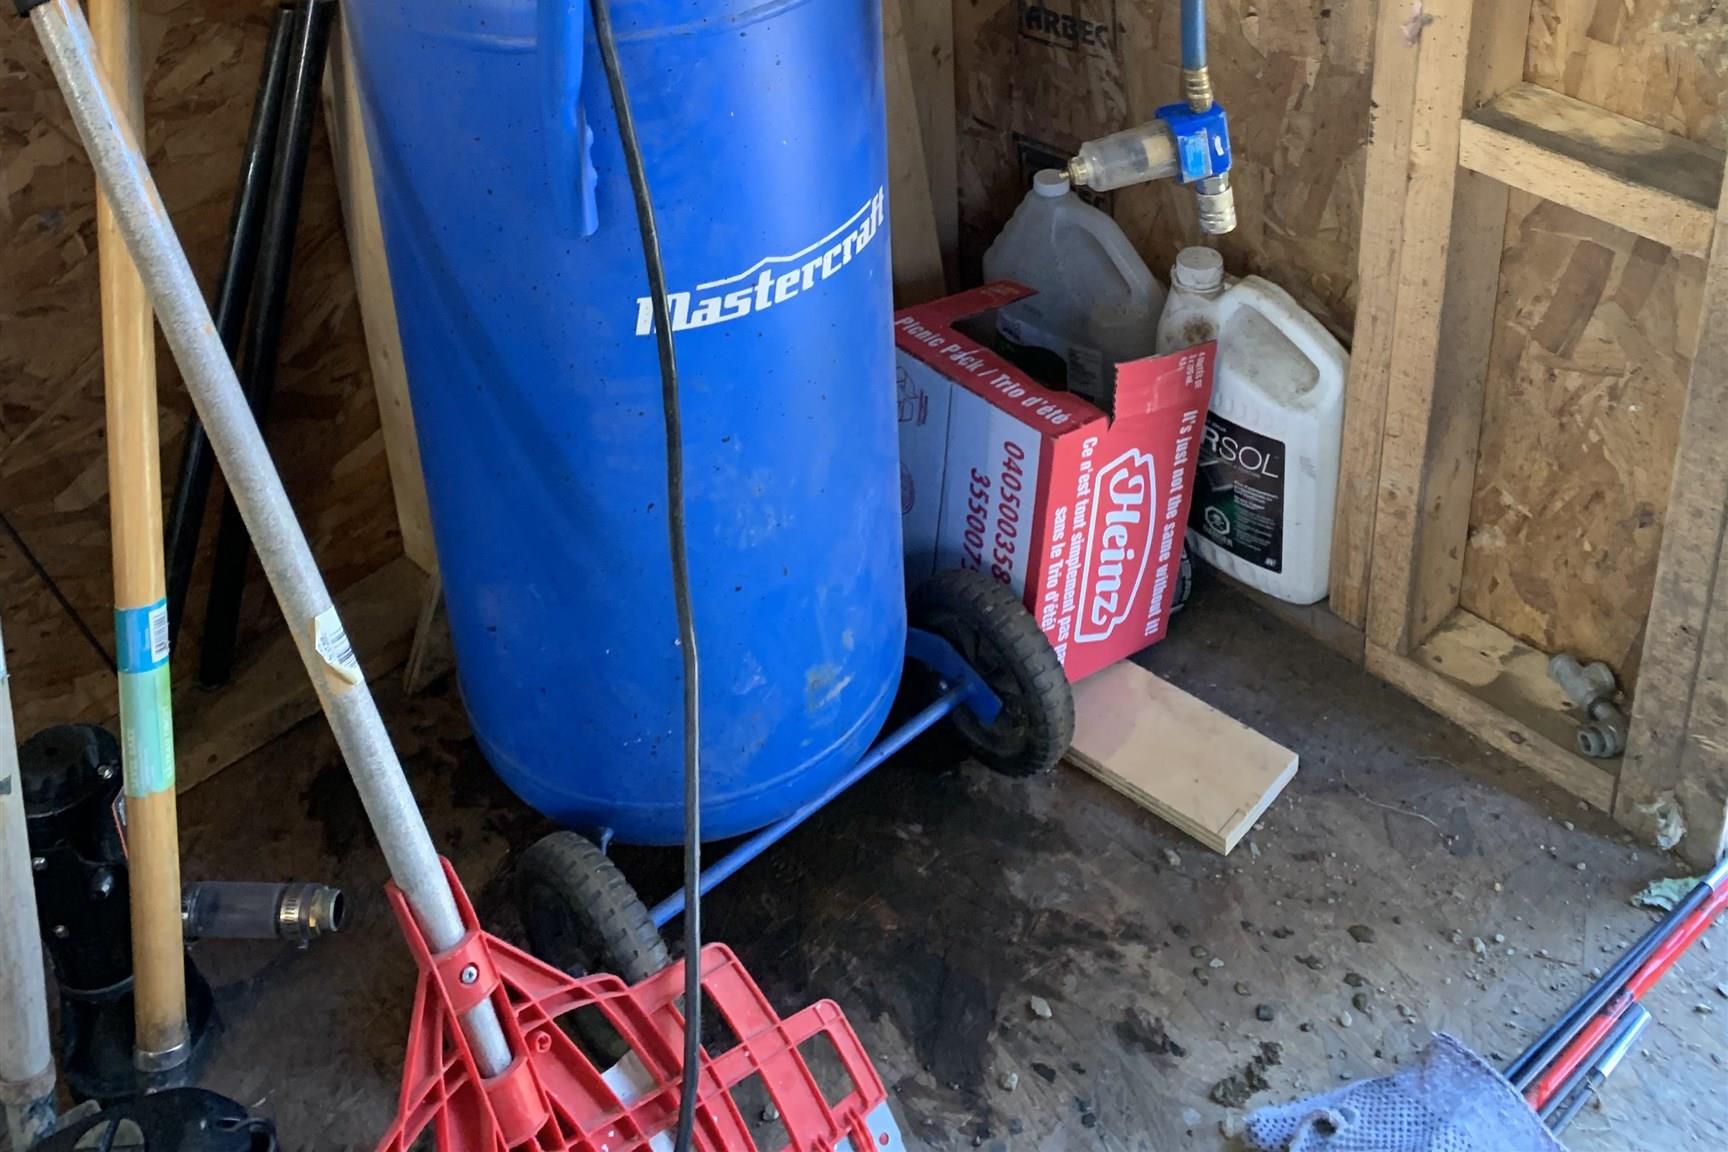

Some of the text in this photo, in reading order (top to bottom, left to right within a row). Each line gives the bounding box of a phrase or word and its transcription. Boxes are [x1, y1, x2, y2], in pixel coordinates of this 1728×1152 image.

[635, 185, 885, 336] Mastercraft
[895, 316, 945, 348] Picnic
[940, 344, 985, 373] Pack
[989, 373, 1026, 399] Trio
[1021, 396, 1073, 425] d'été
[1076, 461, 1095, 498] n'est
[1081, 436, 1099, 459] Ce
[1203, 426, 1279, 479] RSOL
[991, 440, 1025, 585] 040500358
[1072, 498, 1090, 530] tout
[1091, 467, 1145, 626] Heinz
[1144, 409, 1200, 637] It's just not the same without it!
[1041, 506, 1068, 633] sans le Trio d'été!
[1061, 530, 1085, 615] simplement
[1056, 615, 1072, 643] pas
